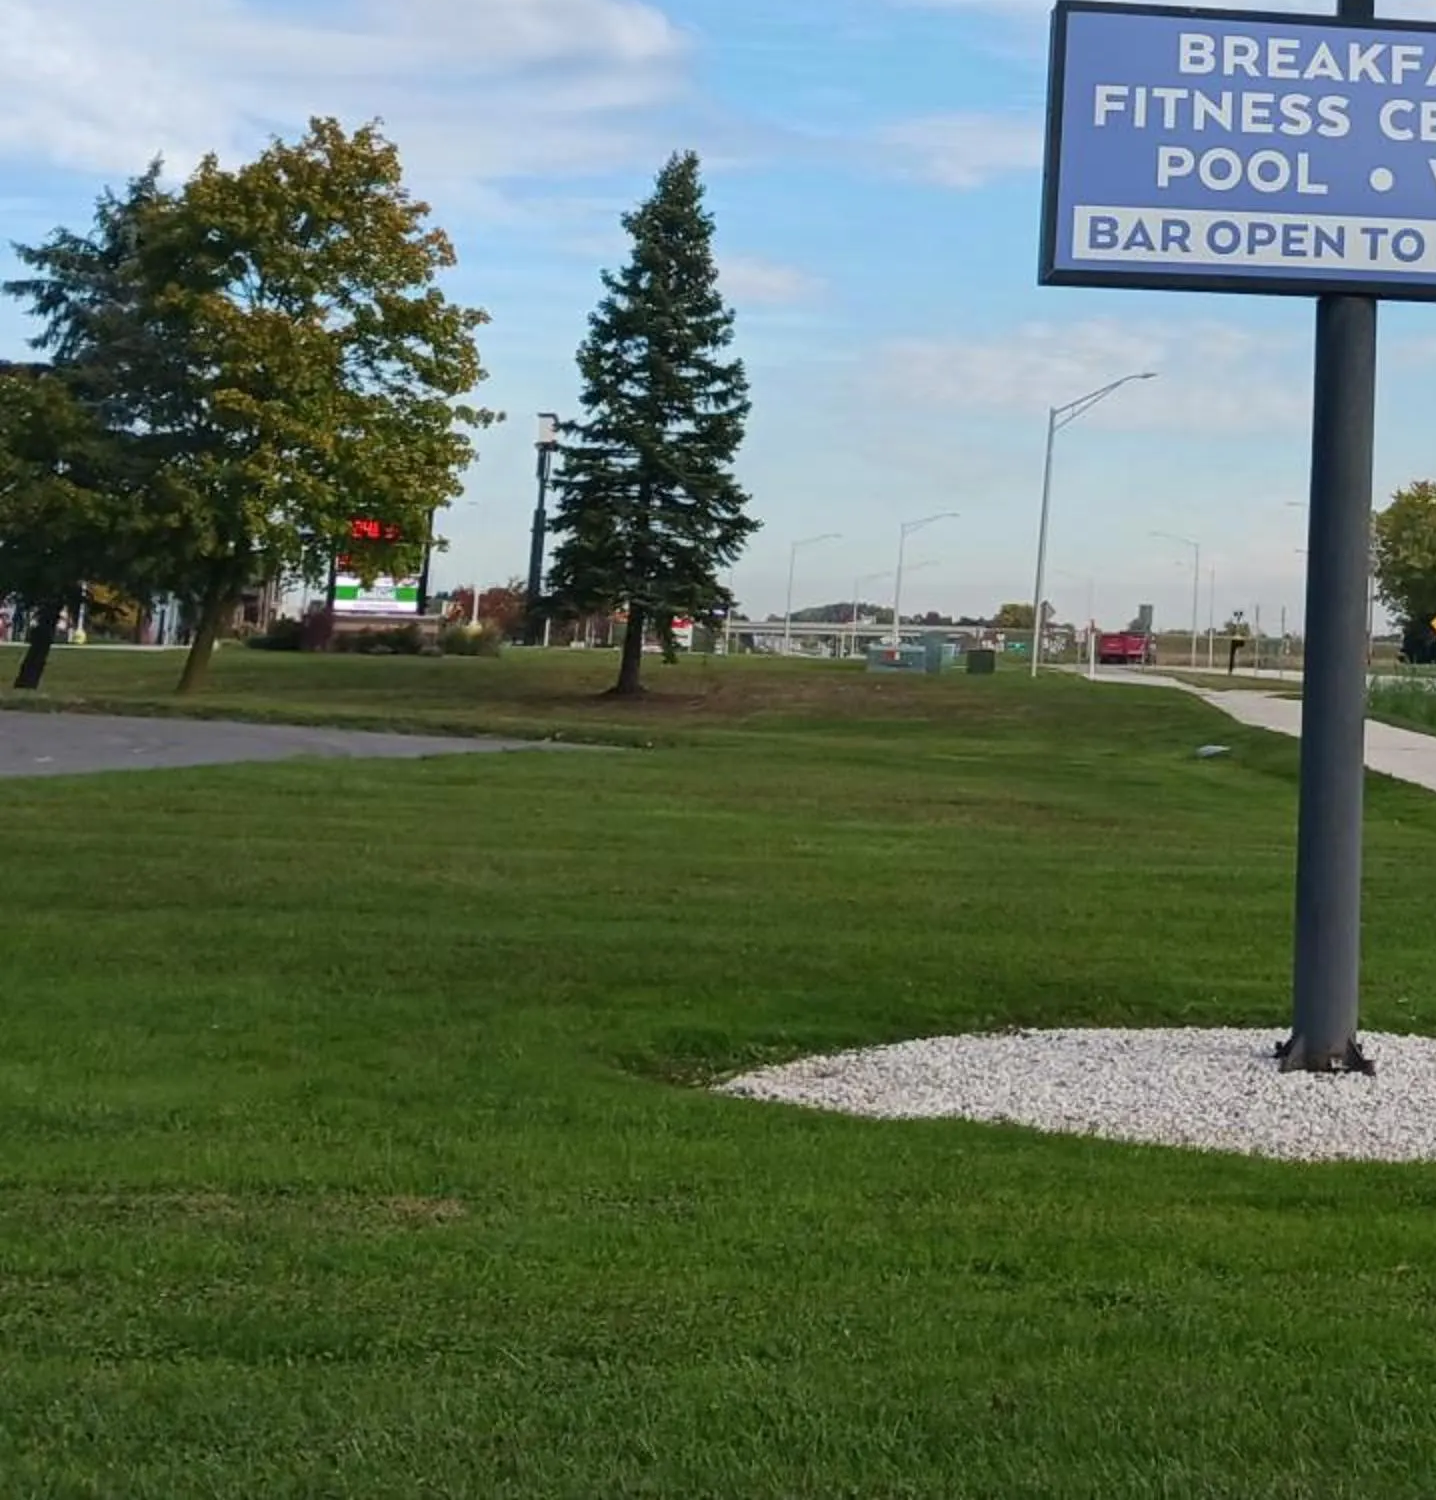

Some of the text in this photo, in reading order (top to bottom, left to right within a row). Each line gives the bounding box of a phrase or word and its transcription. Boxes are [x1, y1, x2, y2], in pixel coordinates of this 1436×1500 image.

[1093, 85, 1350, 138] FITNESS
[1157, 146, 1328, 195] POOL
[1089, 216, 1191, 253] BAR
[1206, 219, 1345, 259] OPEN
[1361, 228, 1425, 263] TO
